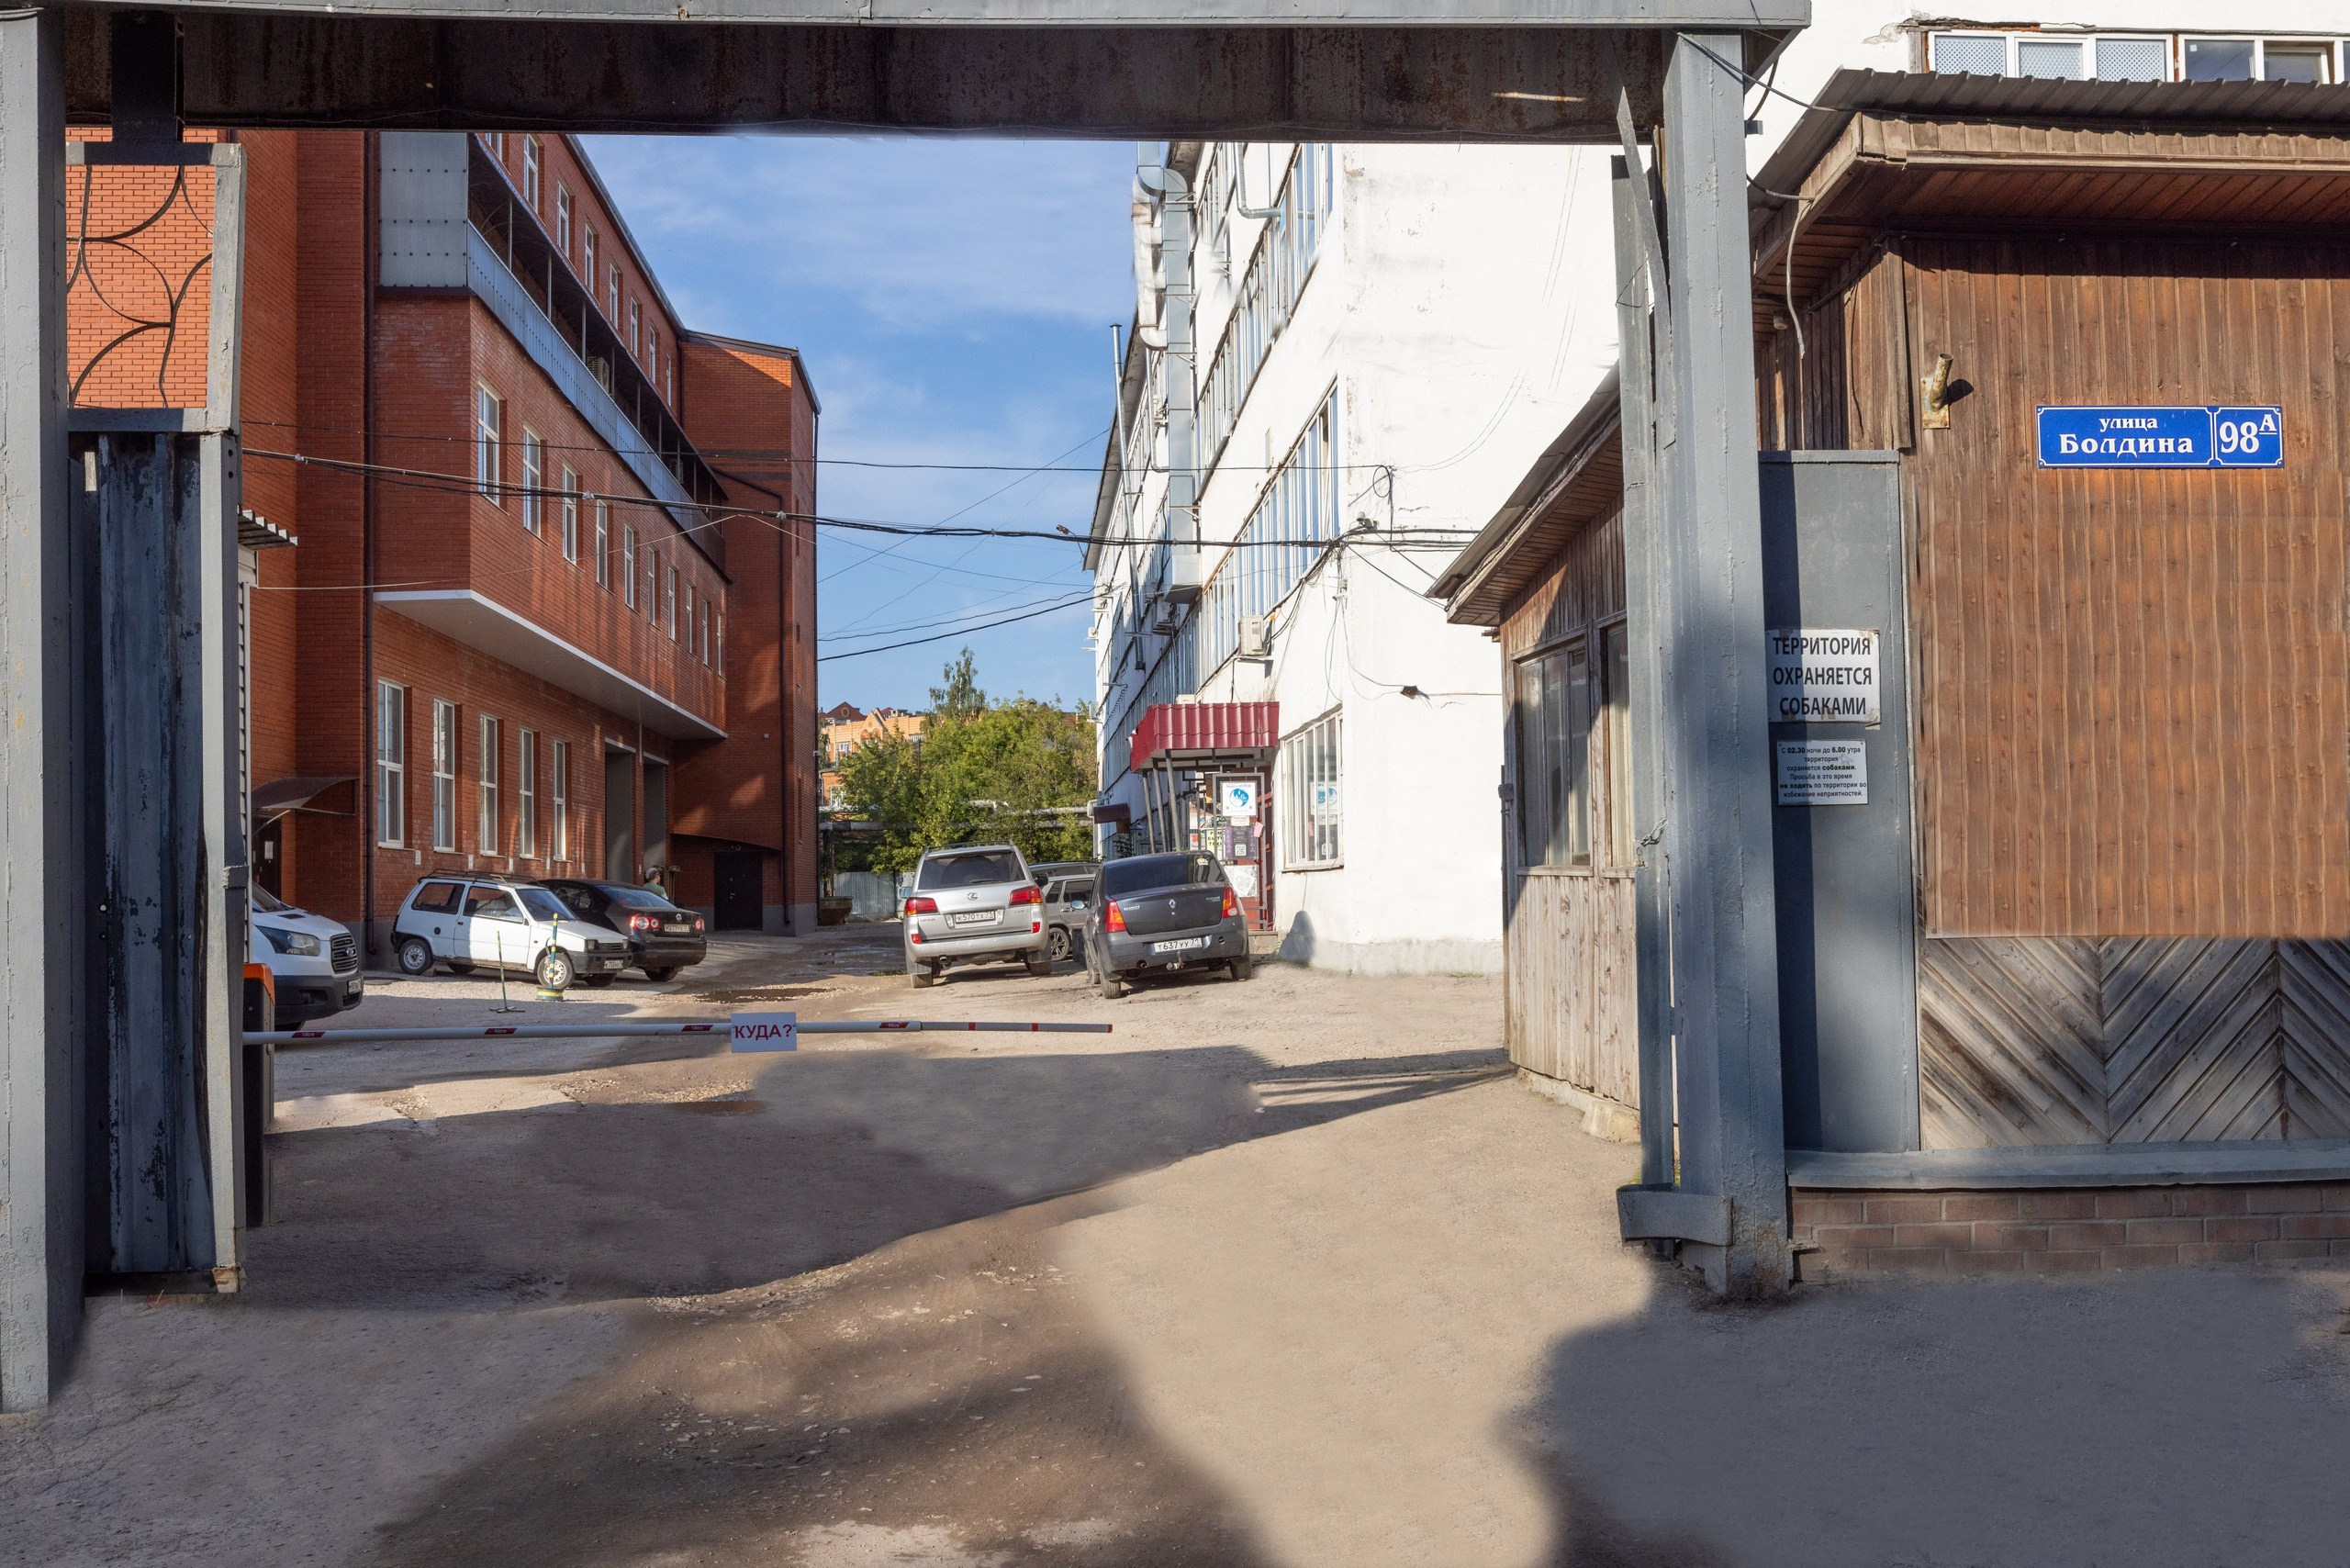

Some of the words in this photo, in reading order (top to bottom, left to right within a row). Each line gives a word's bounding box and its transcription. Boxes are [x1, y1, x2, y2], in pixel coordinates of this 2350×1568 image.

[2098, 417, 2158, 432] улица
[2059, 433, 2194, 458] Болдина
[1773, 637, 1871, 655] ТЕРРИТОРИЯ
[1773, 667, 1872, 685] ОХРАНЯЕТСЯ
[1779, 697, 1866, 715] СОБАКАМИ
[734, 1025, 792, 1040] КУДА?
